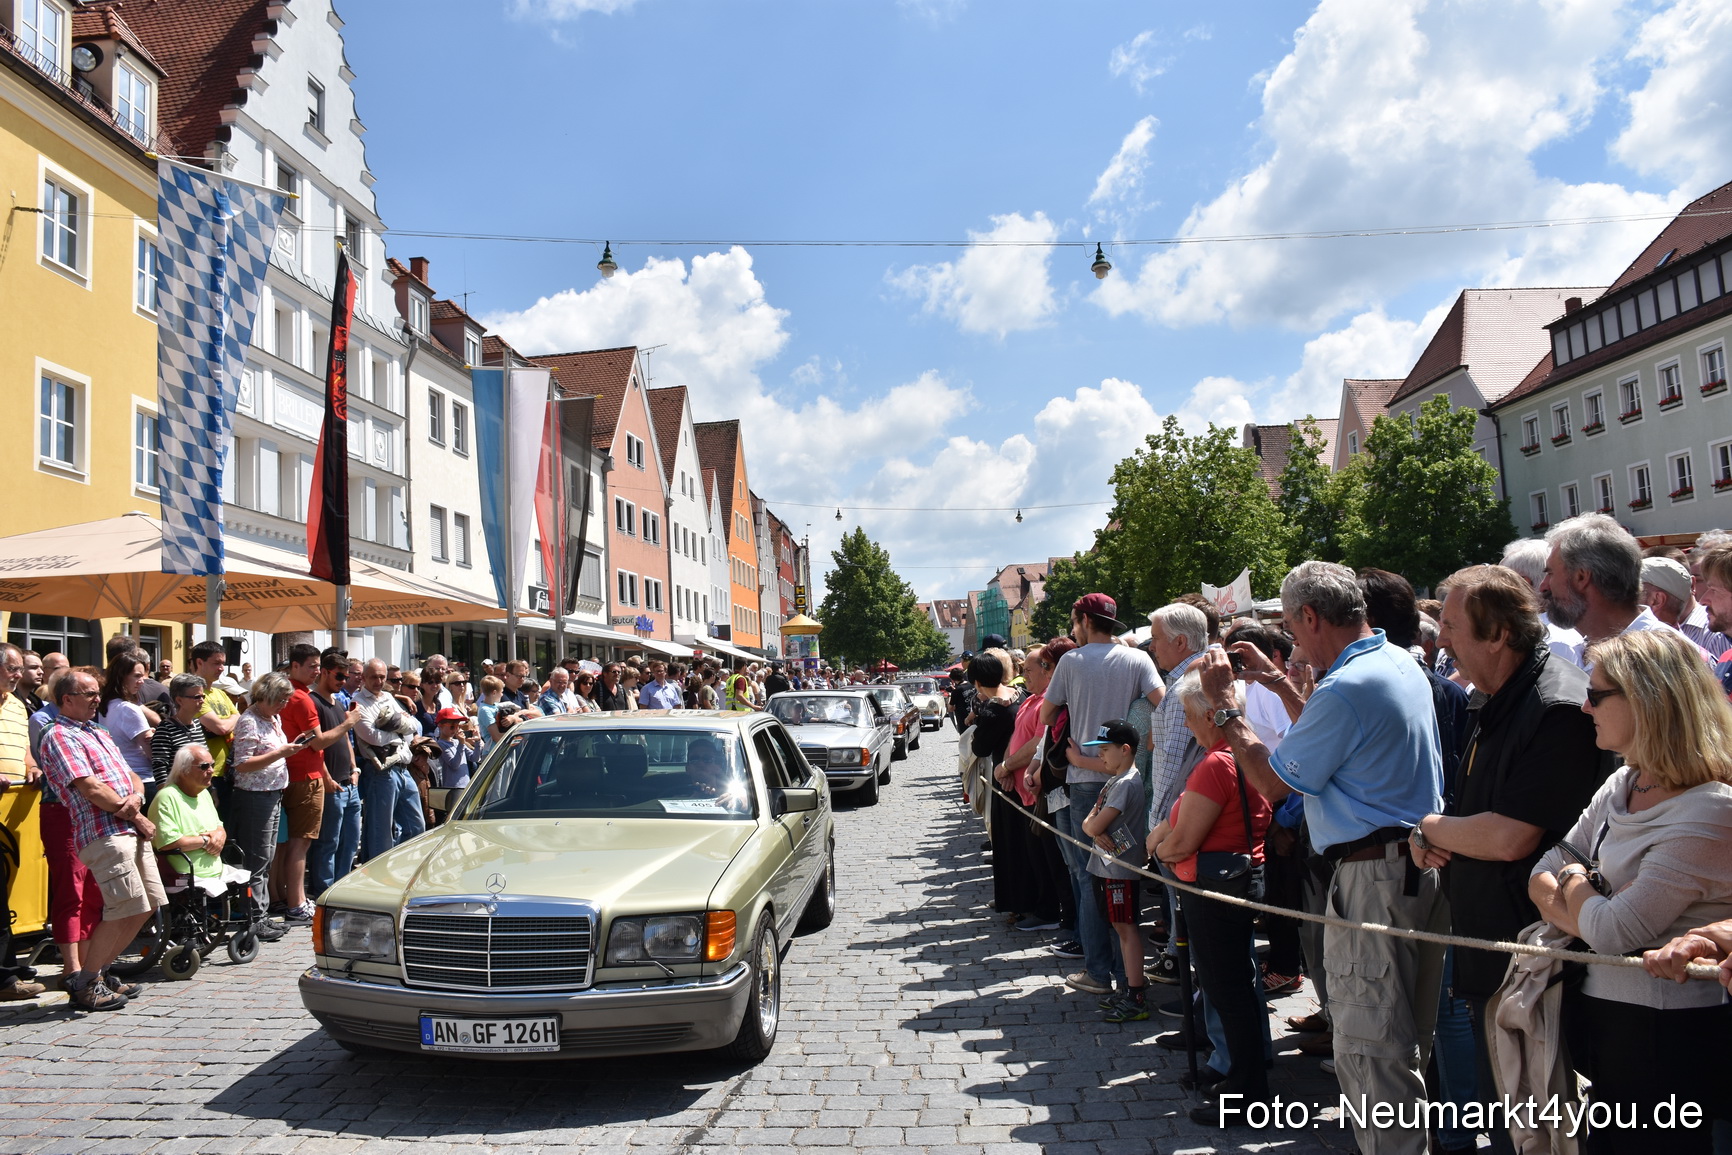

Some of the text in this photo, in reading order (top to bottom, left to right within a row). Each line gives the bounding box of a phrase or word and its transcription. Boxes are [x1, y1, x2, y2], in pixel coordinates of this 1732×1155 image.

[278, 393, 321, 428] BRILLEN
[174, 639, 182, 650] 24
[434, 1021, 557, 1045] AN GF 126H
